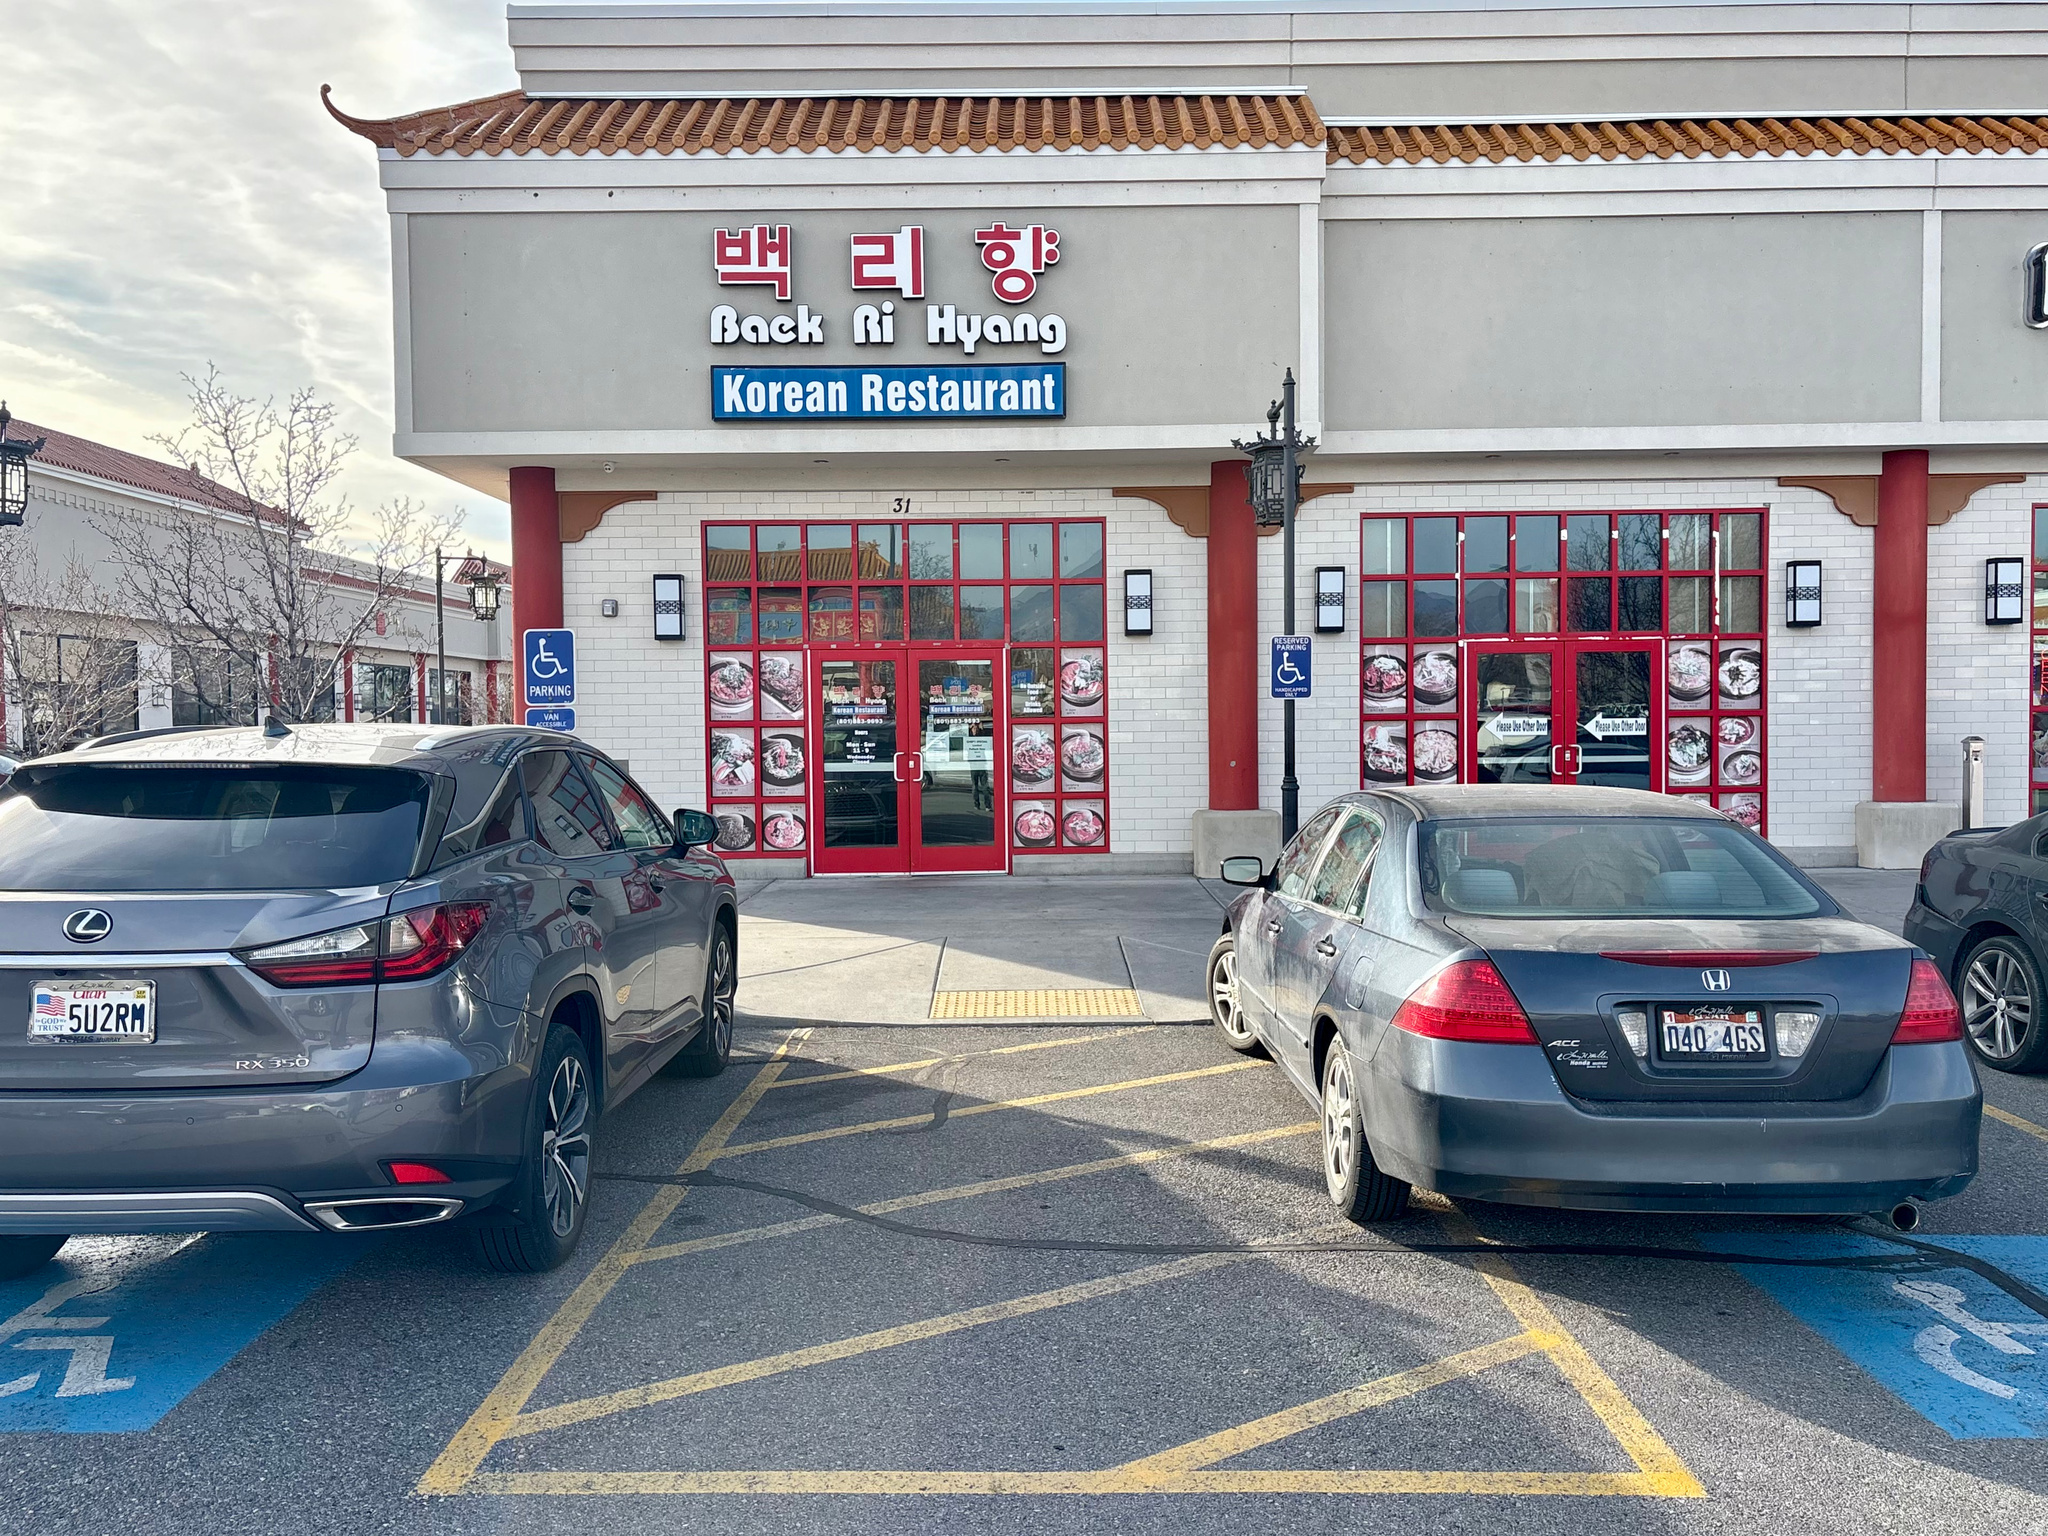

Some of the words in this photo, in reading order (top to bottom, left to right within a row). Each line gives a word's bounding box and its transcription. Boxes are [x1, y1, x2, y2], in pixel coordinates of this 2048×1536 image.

[713, 224, 792, 301] 백
[850, 225, 925, 300] 리
[974, 221, 1061, 304] 향
[709, 303, 825, 345] Baek
[852, 300, 895, 345] Ri
[926, 303, 1068, 355] Hyang
[722, 374, 848, 414] Korean
[861, 373, 1056, 412] Restaurant
[892, 497, 911, 514] 31
[529, 685, 571, 697] PARKING
[543, 713, 560, 721] VAN
[1496, 719, 1512, 732] Please
[1513, 719, 1522, 732] Use
[1522, 719, 1536, 732] Other
[1536, 719, 1547, 732] Door
[1595, 719, 1611, 732] Please
[1611, 719, 1621, 732] Use
[1621, 719, 1634, 732] Other
[1635, 719, 1646, 732] Door
[41, 1017, 59, 1025] GOD
[69, 1003, 146, 1033] 5U2RM
[37, 1024, 65, 1032] TRUST
[1547, 1039, 1581, 1047] ACC
[1722, 1025, 1762, 1052] 4GS
[235, 1059, 265, 1070] RX
[267, 1057, 310, 1069] 350
